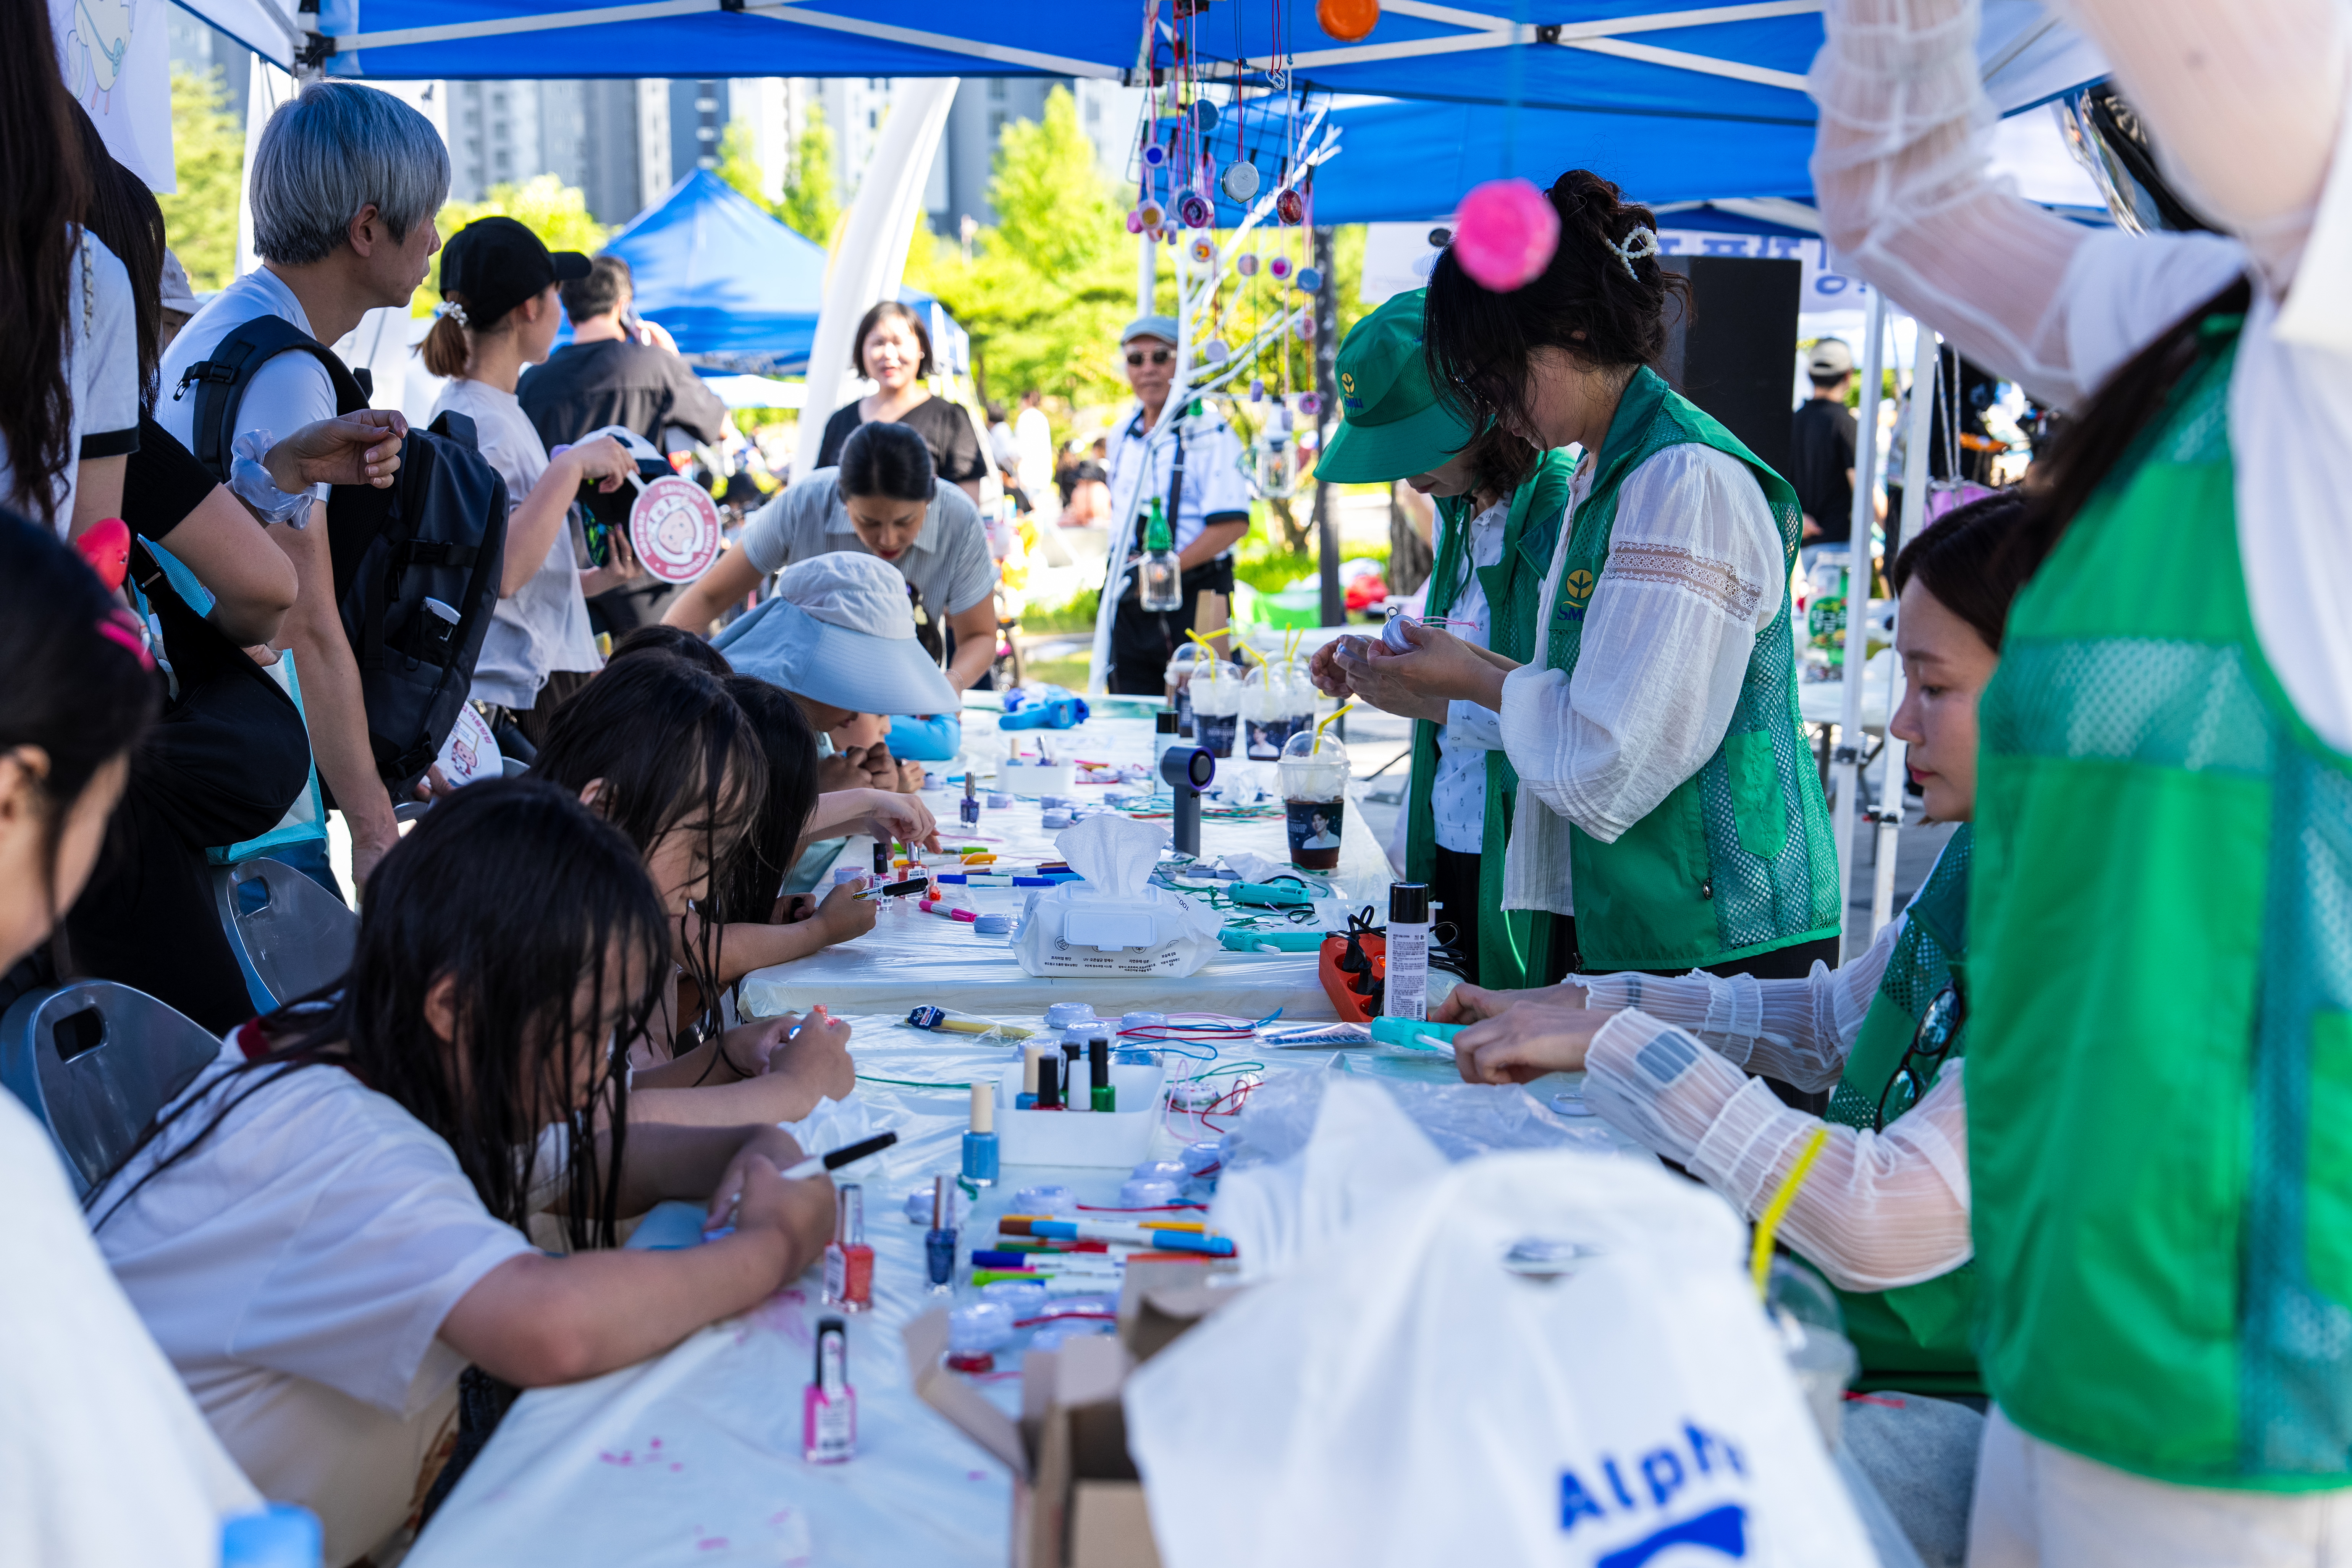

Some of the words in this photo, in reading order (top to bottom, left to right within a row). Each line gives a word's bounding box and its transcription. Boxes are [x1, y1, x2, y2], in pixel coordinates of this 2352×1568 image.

[1344, 396, 1364, 408] SMU
[1557, 604, 1586, 621] SM
[1179, 899, 1189, 911] 100
